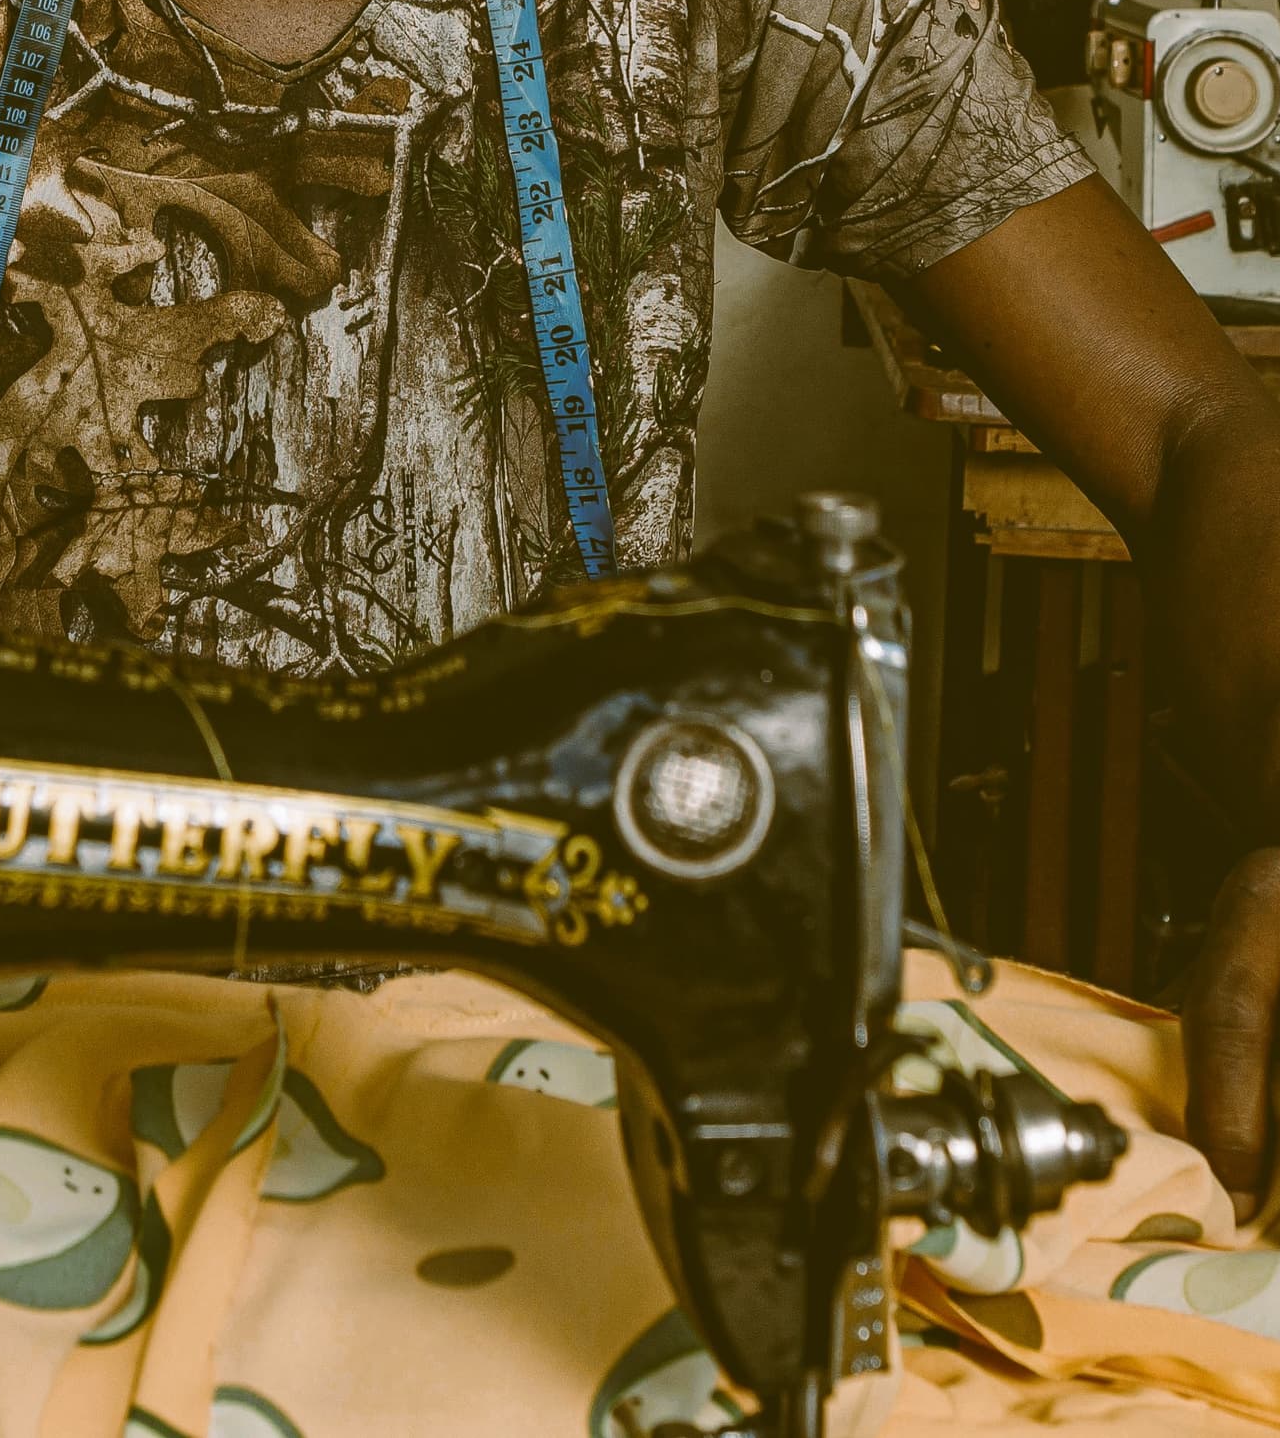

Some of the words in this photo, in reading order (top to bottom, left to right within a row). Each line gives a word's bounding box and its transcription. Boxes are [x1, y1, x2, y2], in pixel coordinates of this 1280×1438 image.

[28, 21, 51, 42] 106
[21, 49, 44, 68] 107
[511, 38, 536, 83] 24
[12, 77, 35, 97] 108
[5, 105, 27, 125] 109
[518, 109, 546, 153] 23
[529, 180, 553, 225] 22
[540, 251, 566, 297] 21
[551, 324, 578, 368] 20
[564, 395, 588, 436] 19
[574, 467, 599, 505] 18
